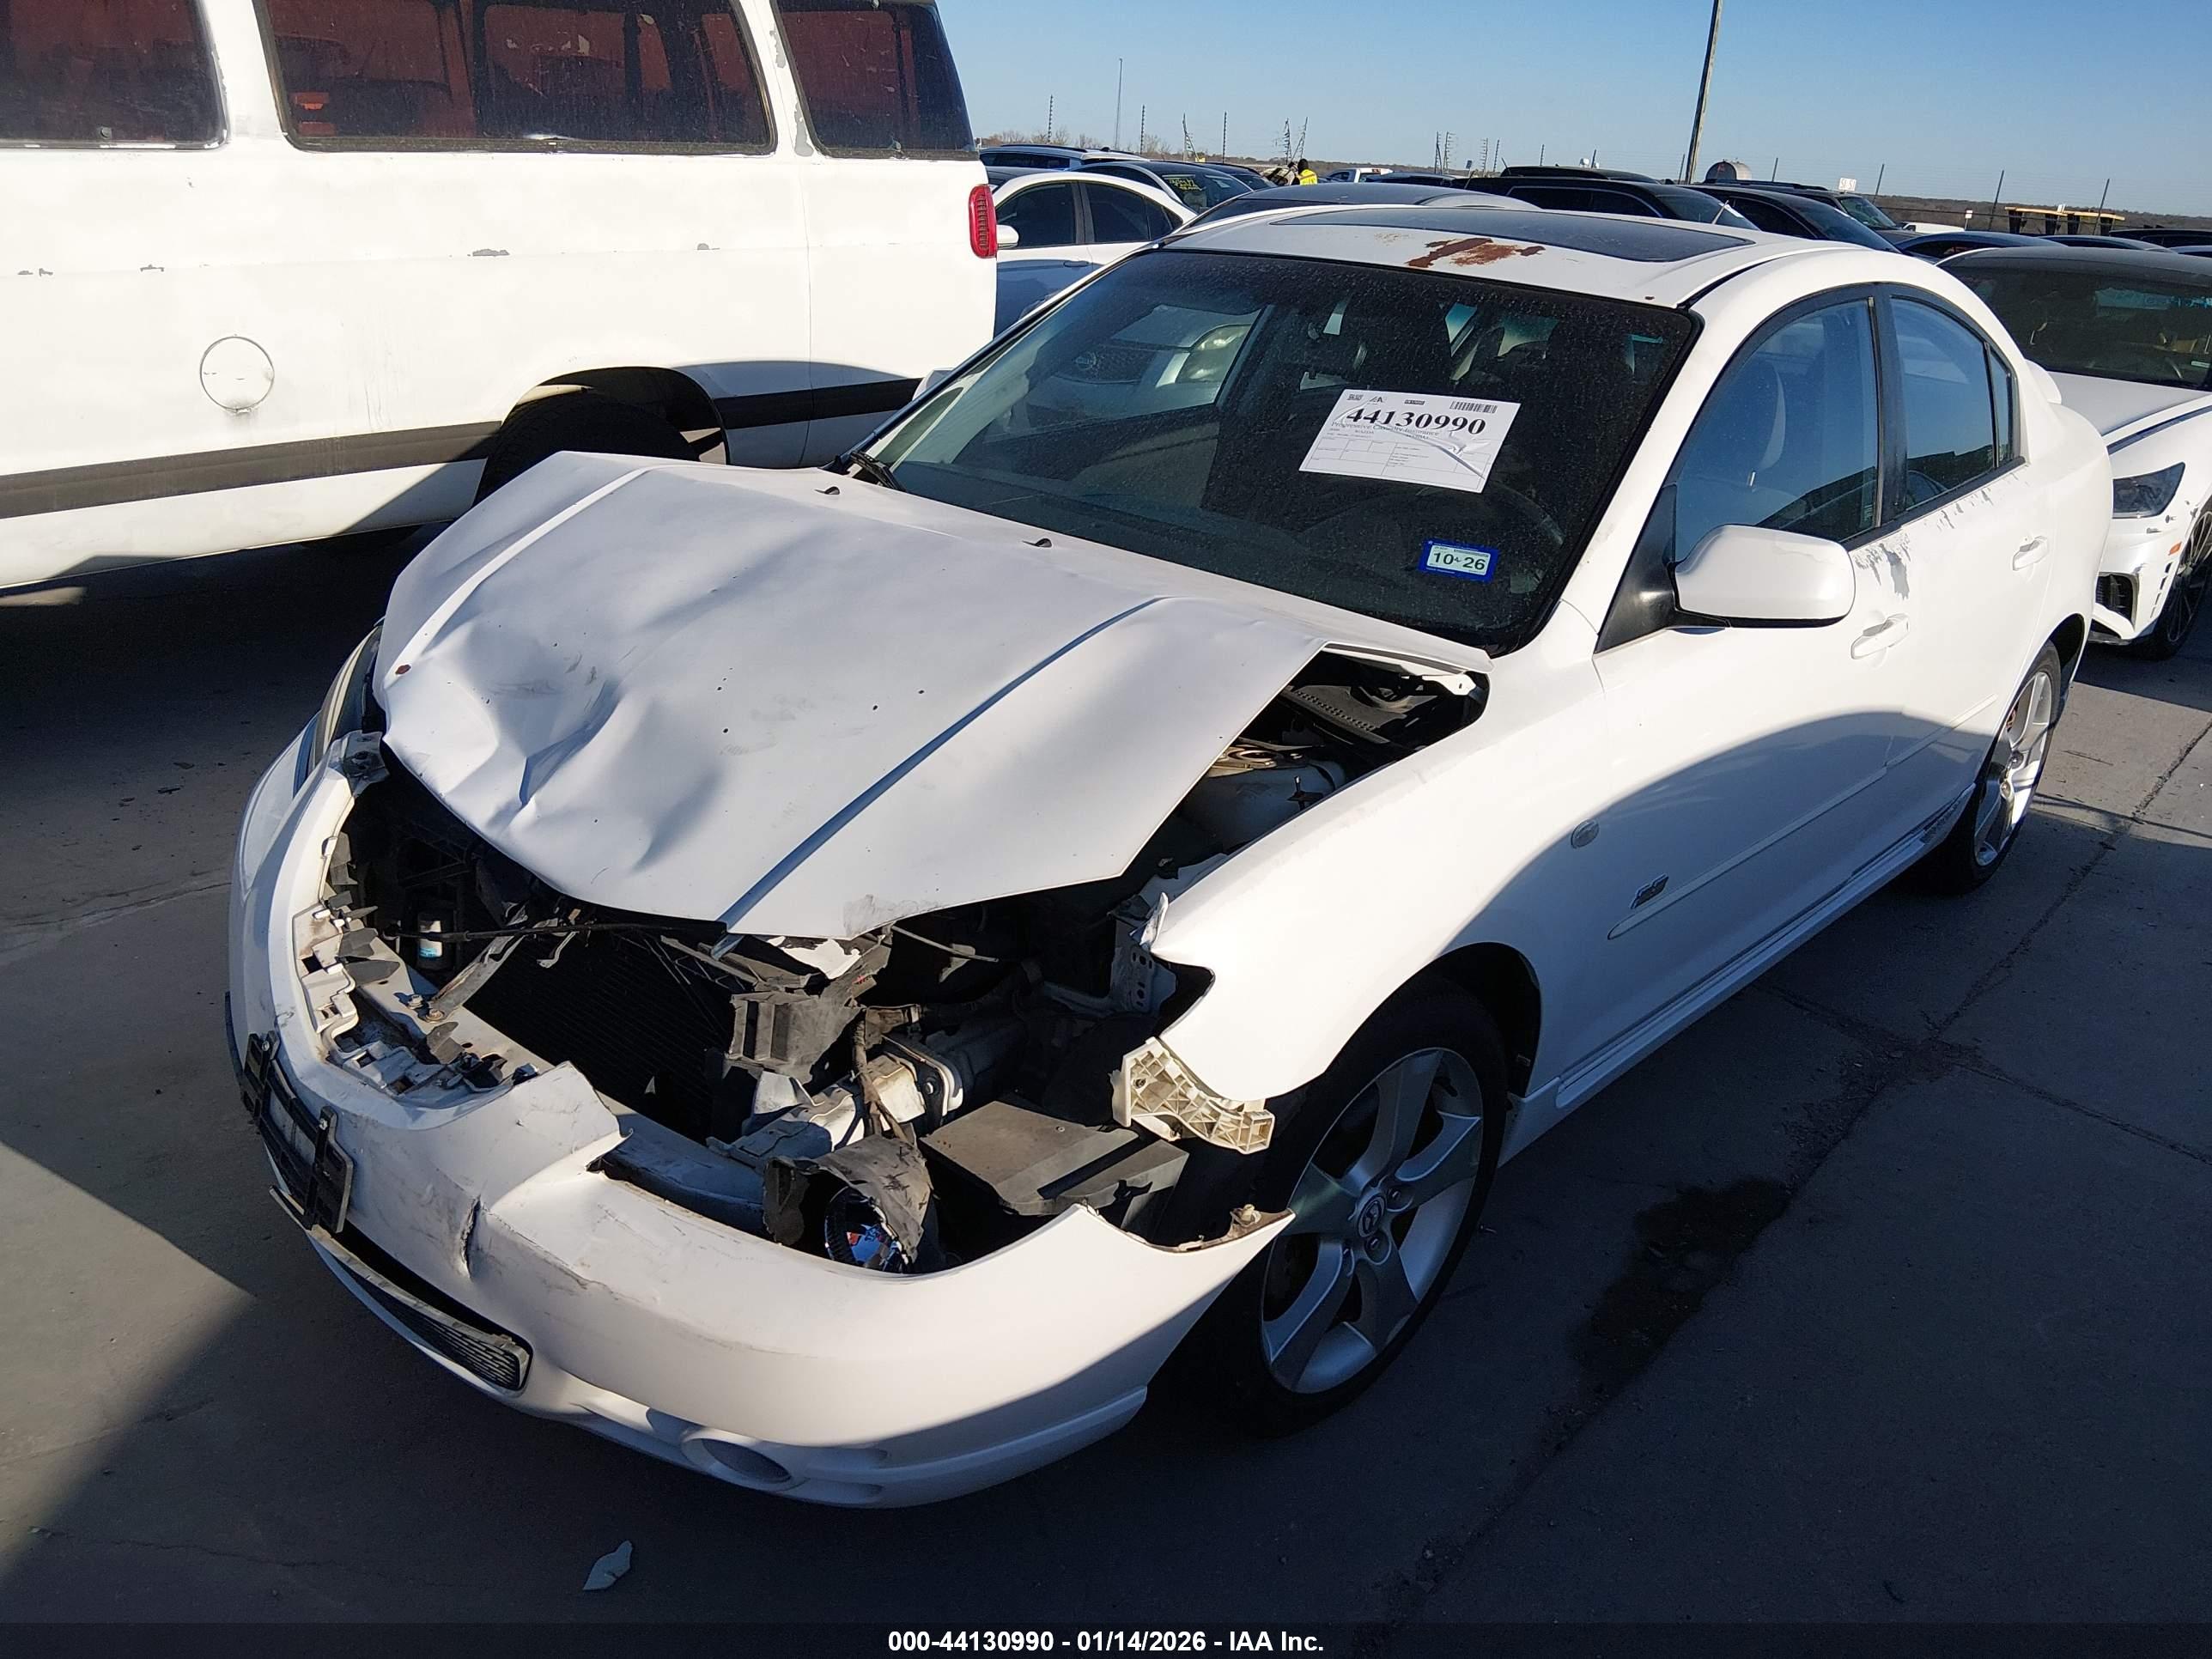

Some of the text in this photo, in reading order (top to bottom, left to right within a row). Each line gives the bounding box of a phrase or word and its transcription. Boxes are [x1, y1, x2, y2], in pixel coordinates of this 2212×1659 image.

[1346, 408, 1486, 435] 44130990
[1434, 552, 1486, 570] 10 26
